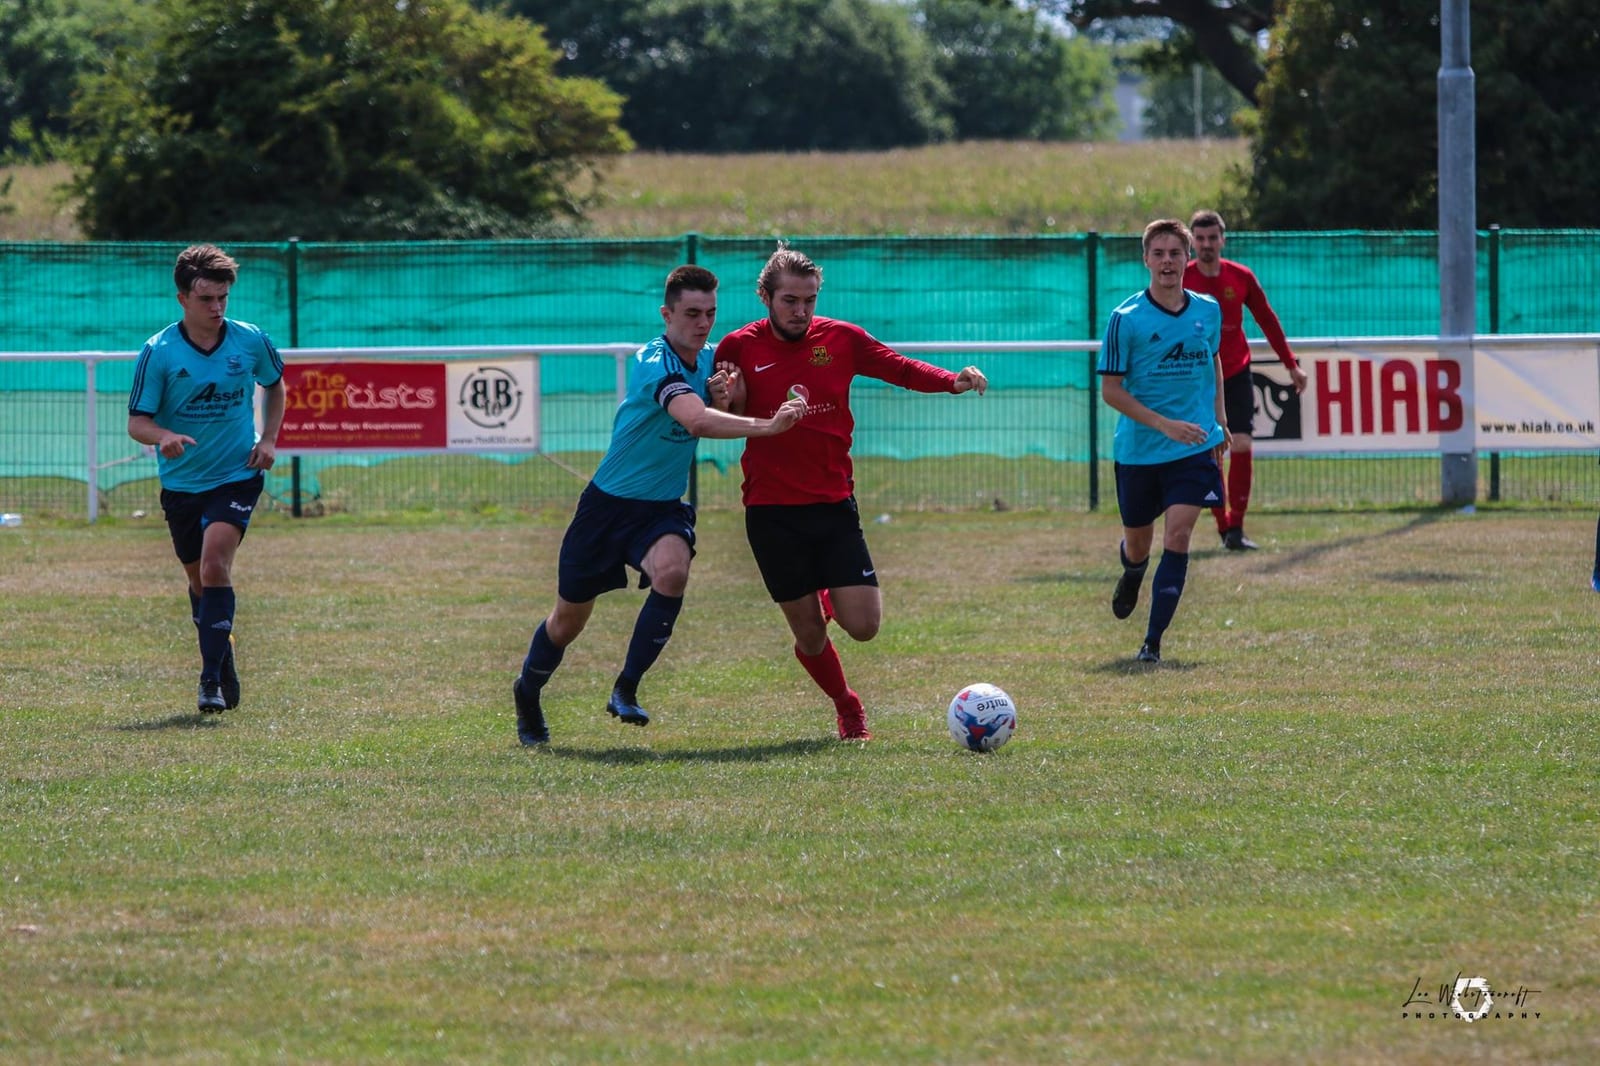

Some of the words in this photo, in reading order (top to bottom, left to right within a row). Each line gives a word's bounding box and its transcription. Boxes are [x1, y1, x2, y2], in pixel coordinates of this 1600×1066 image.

[1160, 342, 1208, 362] Asset
[301, 370, 345, 389] The
[190, 383, 244, 403] Asset
[1316, 359, 1463, 436] HIAB
[283, 422, 299, 431] For
[341, 422, 360, 432] Sign
[1481, 420, 1595, 434] www.hiab.co.uk
[977, 698, 1008, 712] mitre
